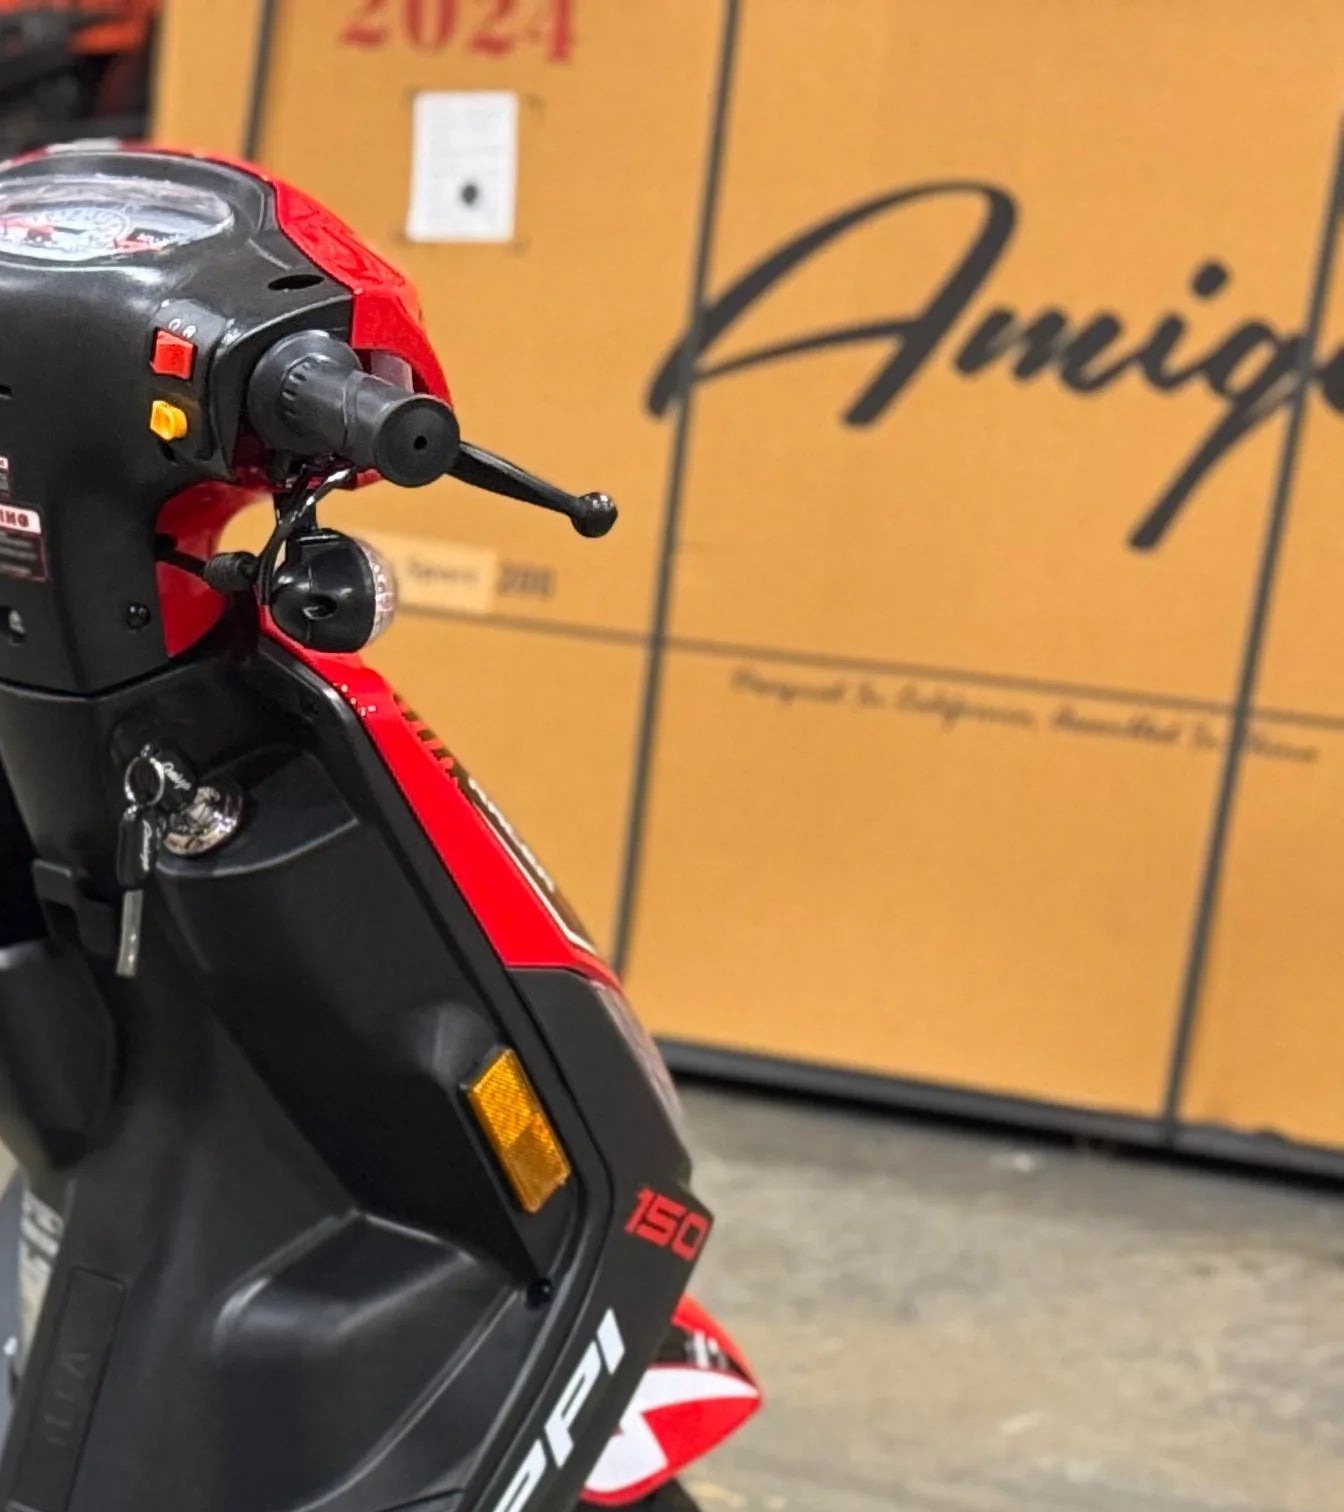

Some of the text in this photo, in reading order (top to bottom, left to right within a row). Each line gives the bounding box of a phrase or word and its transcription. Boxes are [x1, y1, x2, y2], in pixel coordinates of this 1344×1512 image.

[336, 0, 577, 64] 2024
[645, 179, 1344, 553] Amig
[625, 1187, 710, 1261] 150
